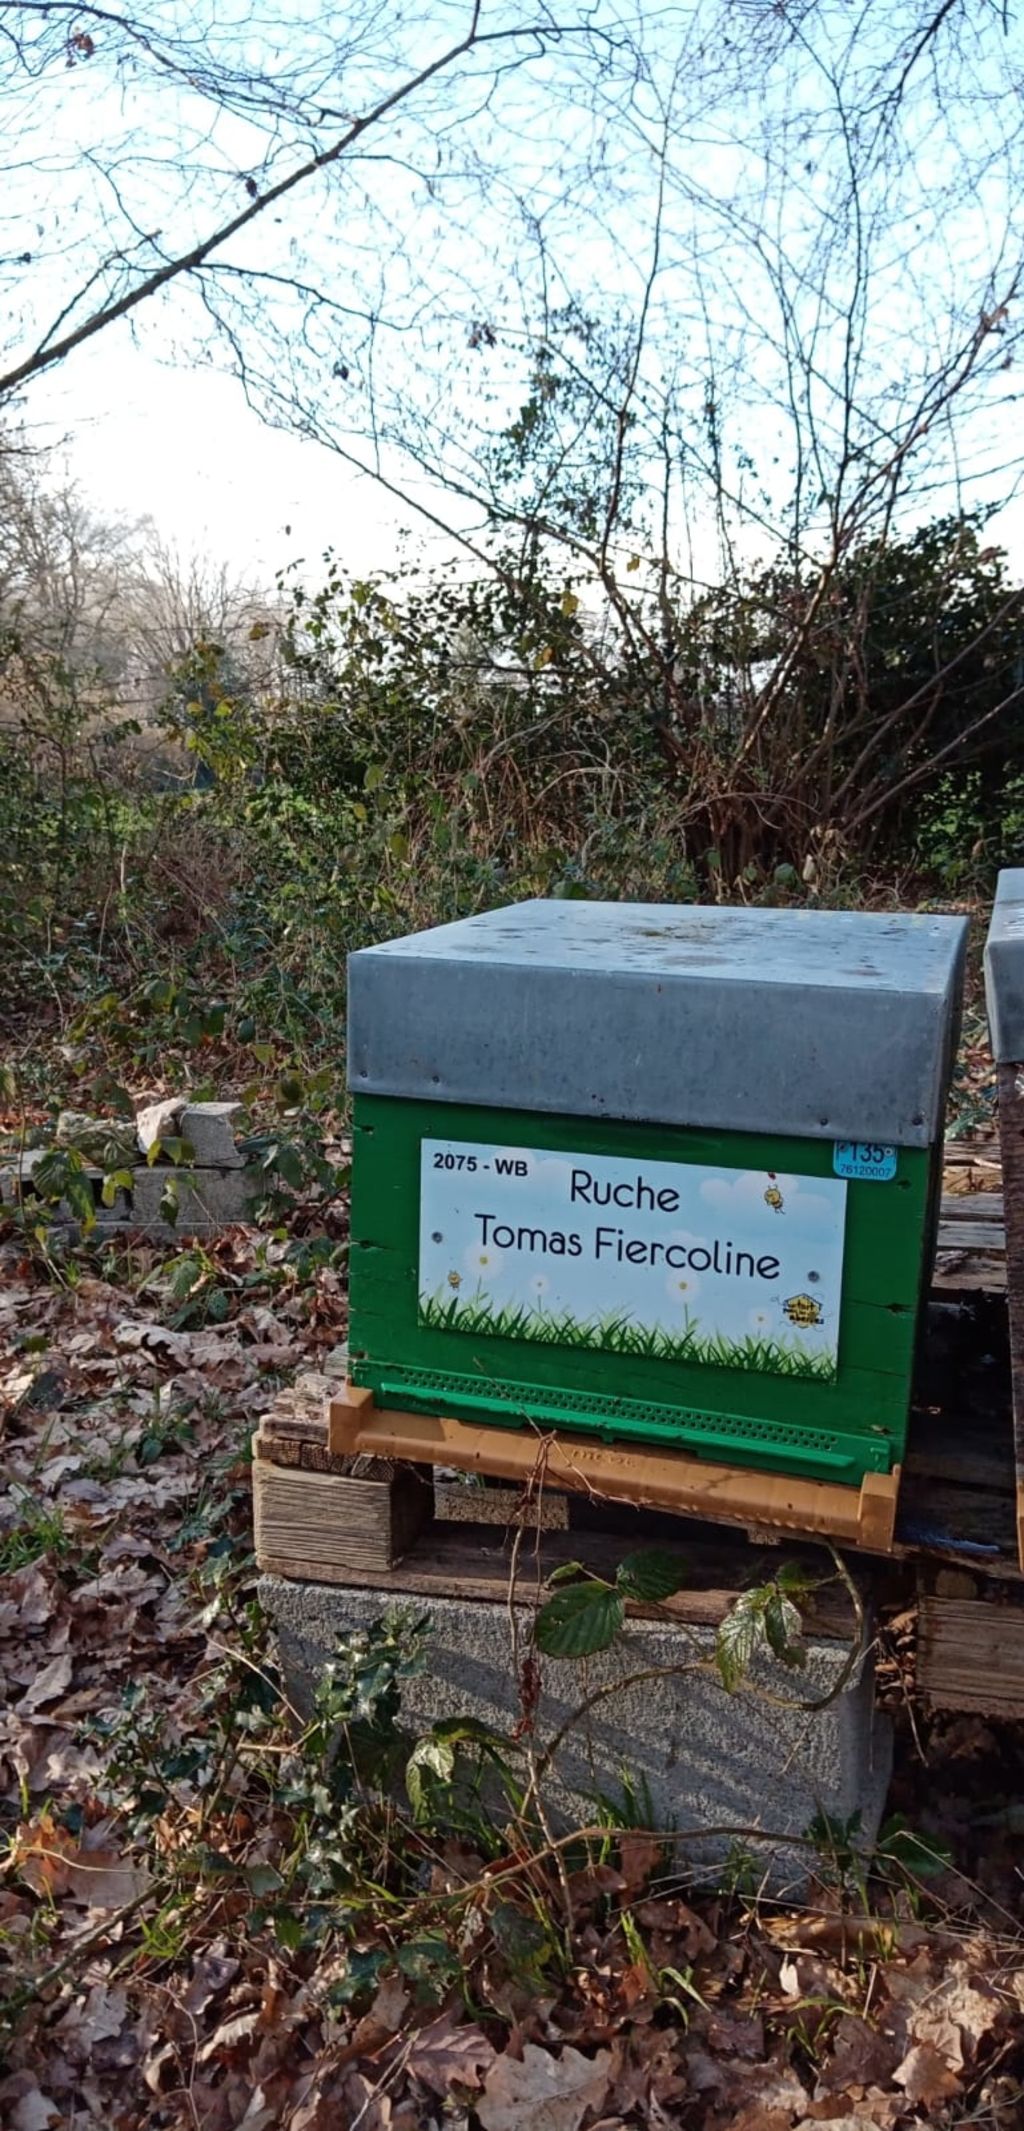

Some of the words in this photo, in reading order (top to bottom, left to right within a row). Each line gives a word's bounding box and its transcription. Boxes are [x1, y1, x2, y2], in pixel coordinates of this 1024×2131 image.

[433, 1153, 478, 1172] 2075
[494, 1158, 529, 1177] WB
[571, 1170, 680, 1213] Ruche
[474, 1214, 583, 1257] Tomas
[595, 1227, 780, 1280] Fiercoline
